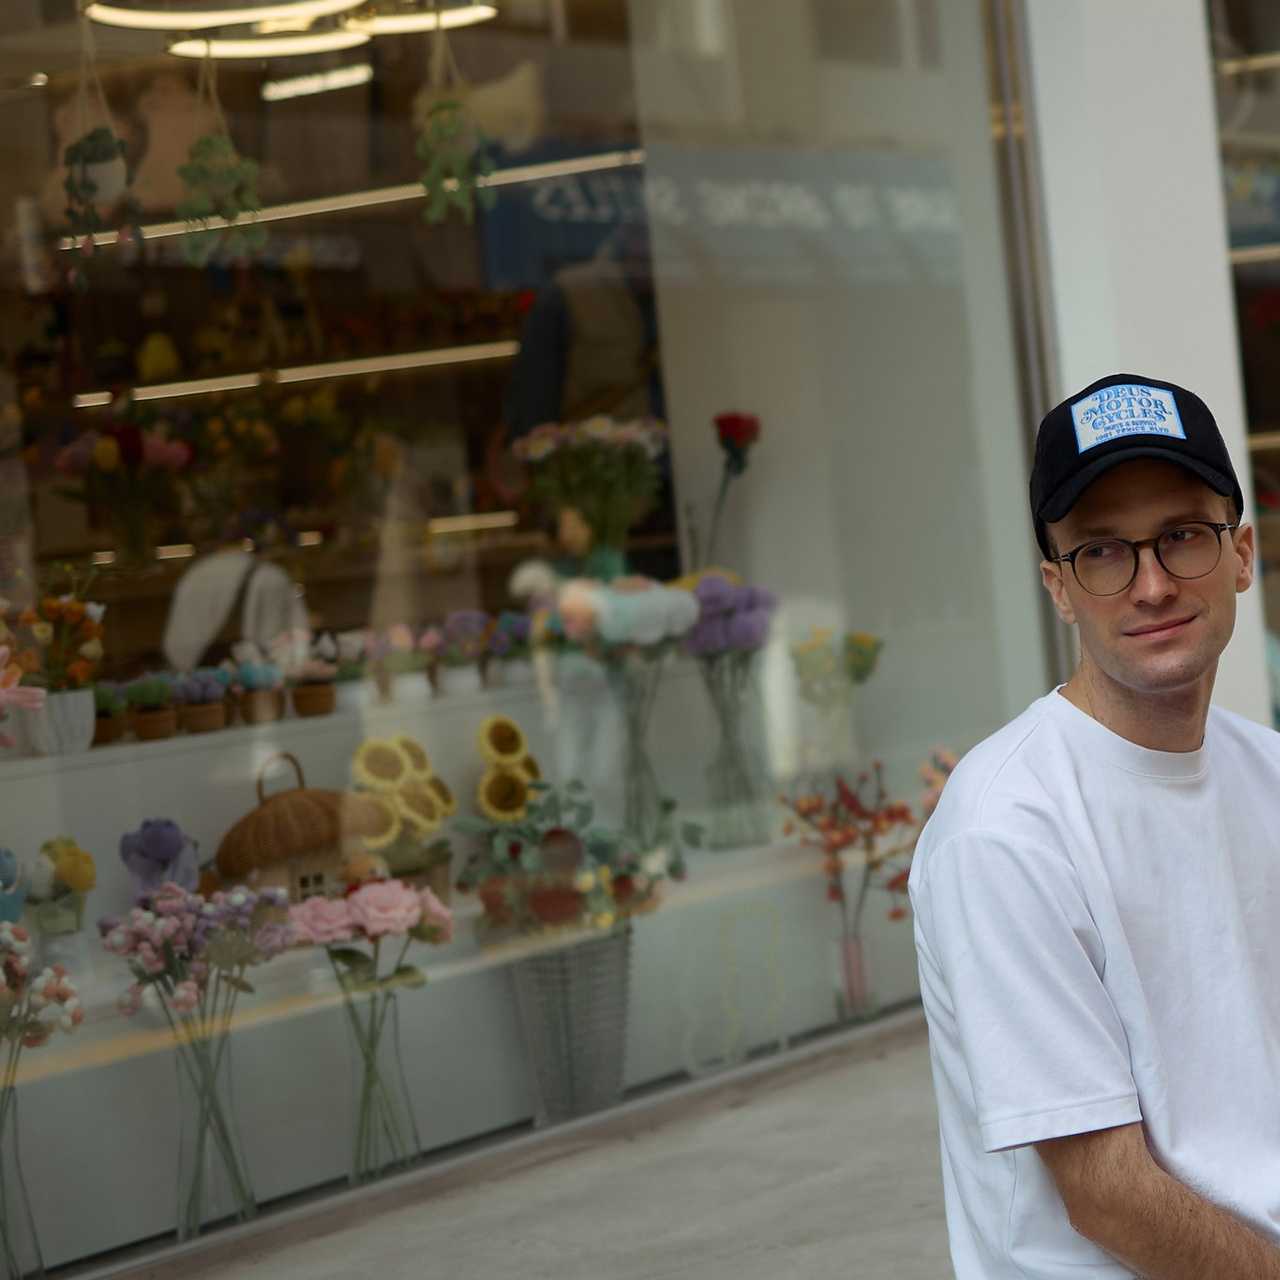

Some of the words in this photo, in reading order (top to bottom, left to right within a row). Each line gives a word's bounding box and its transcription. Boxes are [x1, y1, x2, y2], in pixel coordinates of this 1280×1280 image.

[1092, 387, 1152, 402] DEUS
[1081, 397, 1172, 424] MOTOR
[1092, 408, 1166, 430] CYCLES
[1115, 426, 1146, 434] VENICE
